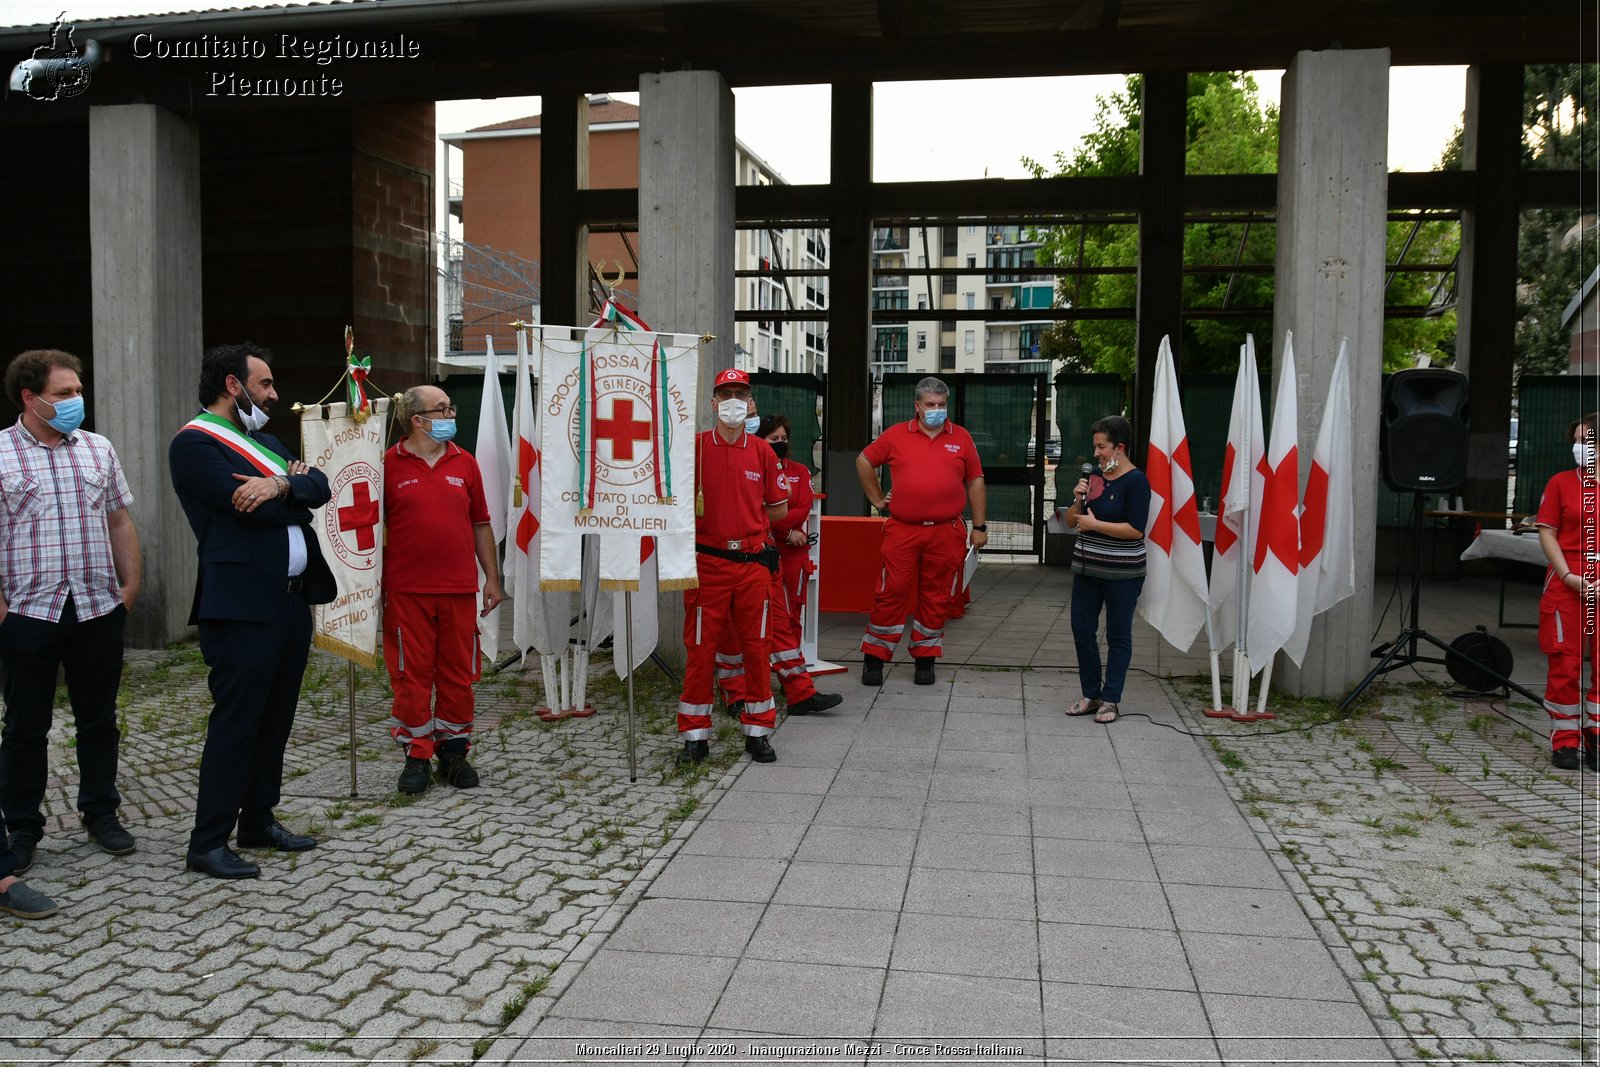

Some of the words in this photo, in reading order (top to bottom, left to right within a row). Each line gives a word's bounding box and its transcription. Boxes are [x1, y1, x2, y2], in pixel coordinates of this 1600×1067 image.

[334, 427, 365, 447] ROSSA
[343, 465, 373, 481] GINEVRA
[561, 491, 627, 504] COTATO
[616, 505, 629, 516] DI
[574, 515, 667, 531] MONCALIERI
[330, 588, 374, 611] COMITATO
[325, 609, 368, 634] SETTIMO
